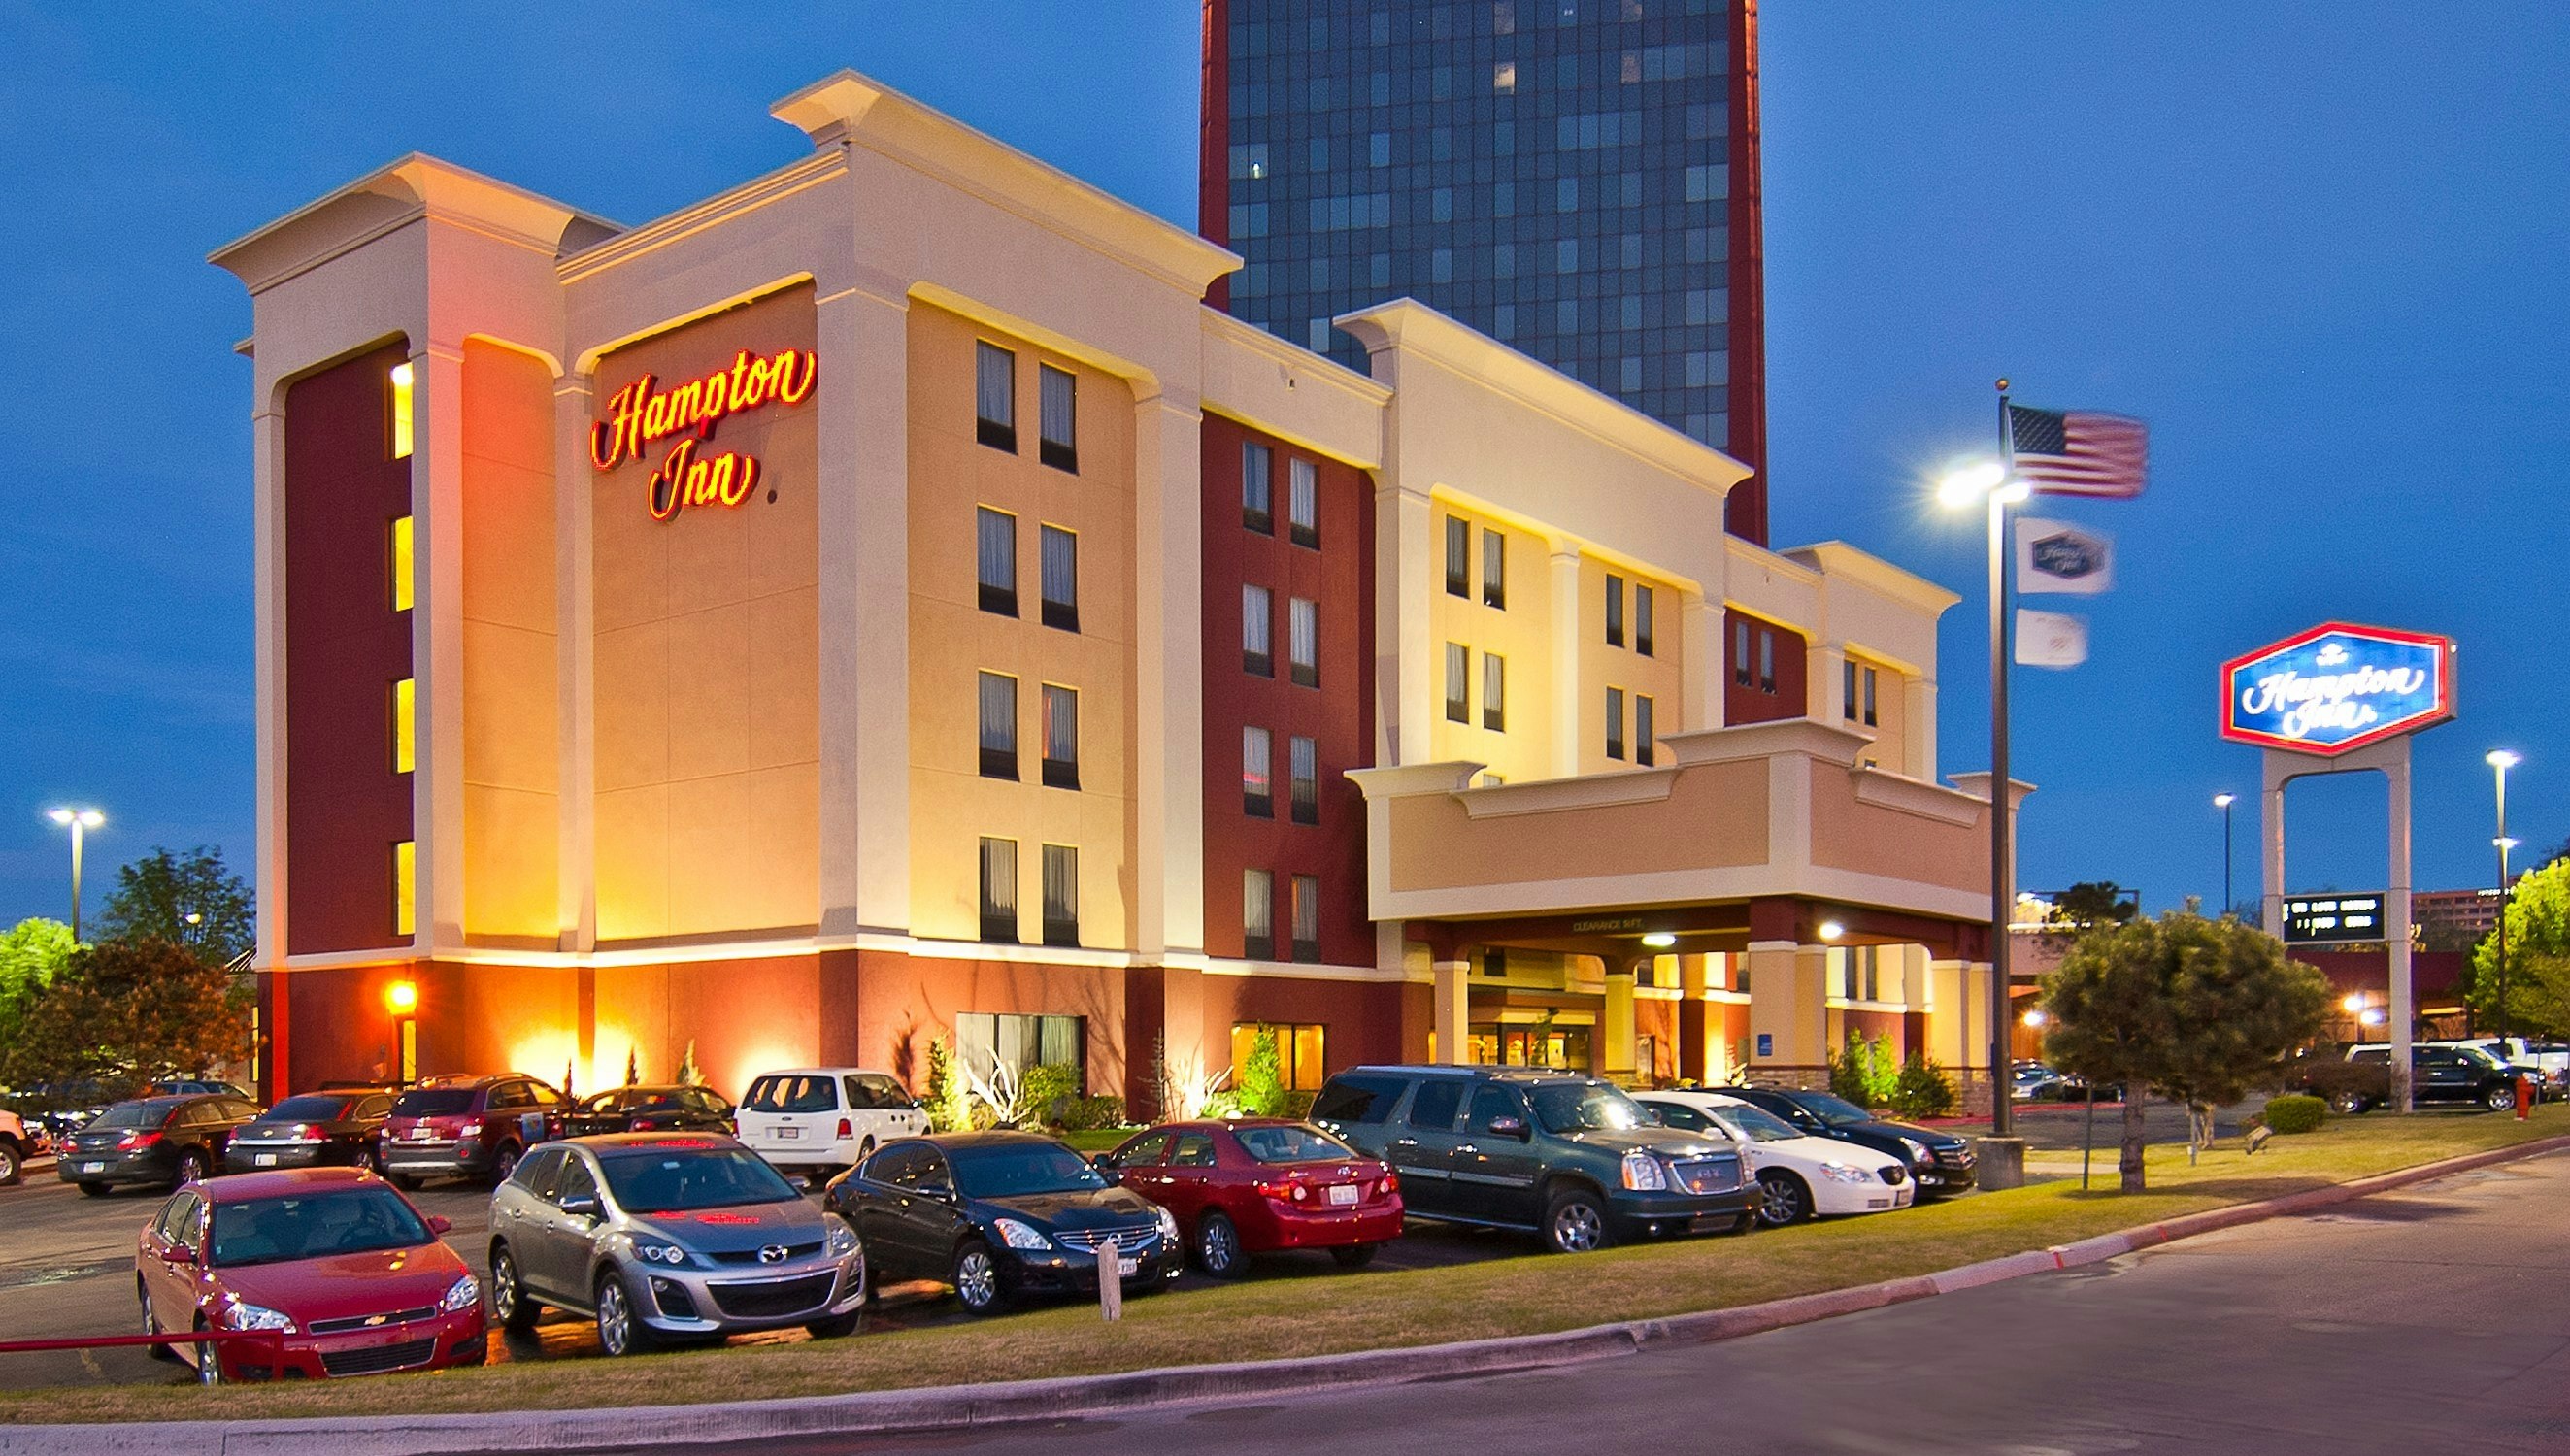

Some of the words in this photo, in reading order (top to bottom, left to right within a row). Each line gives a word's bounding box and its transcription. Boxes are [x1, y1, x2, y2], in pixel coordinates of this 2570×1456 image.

[590, 348, 817, 471] Hampton
[646, 436, 760, 522] Inn
[2242, 665, 2425, 715] Hampton
[2283, 698, 2373, 738] Inn
